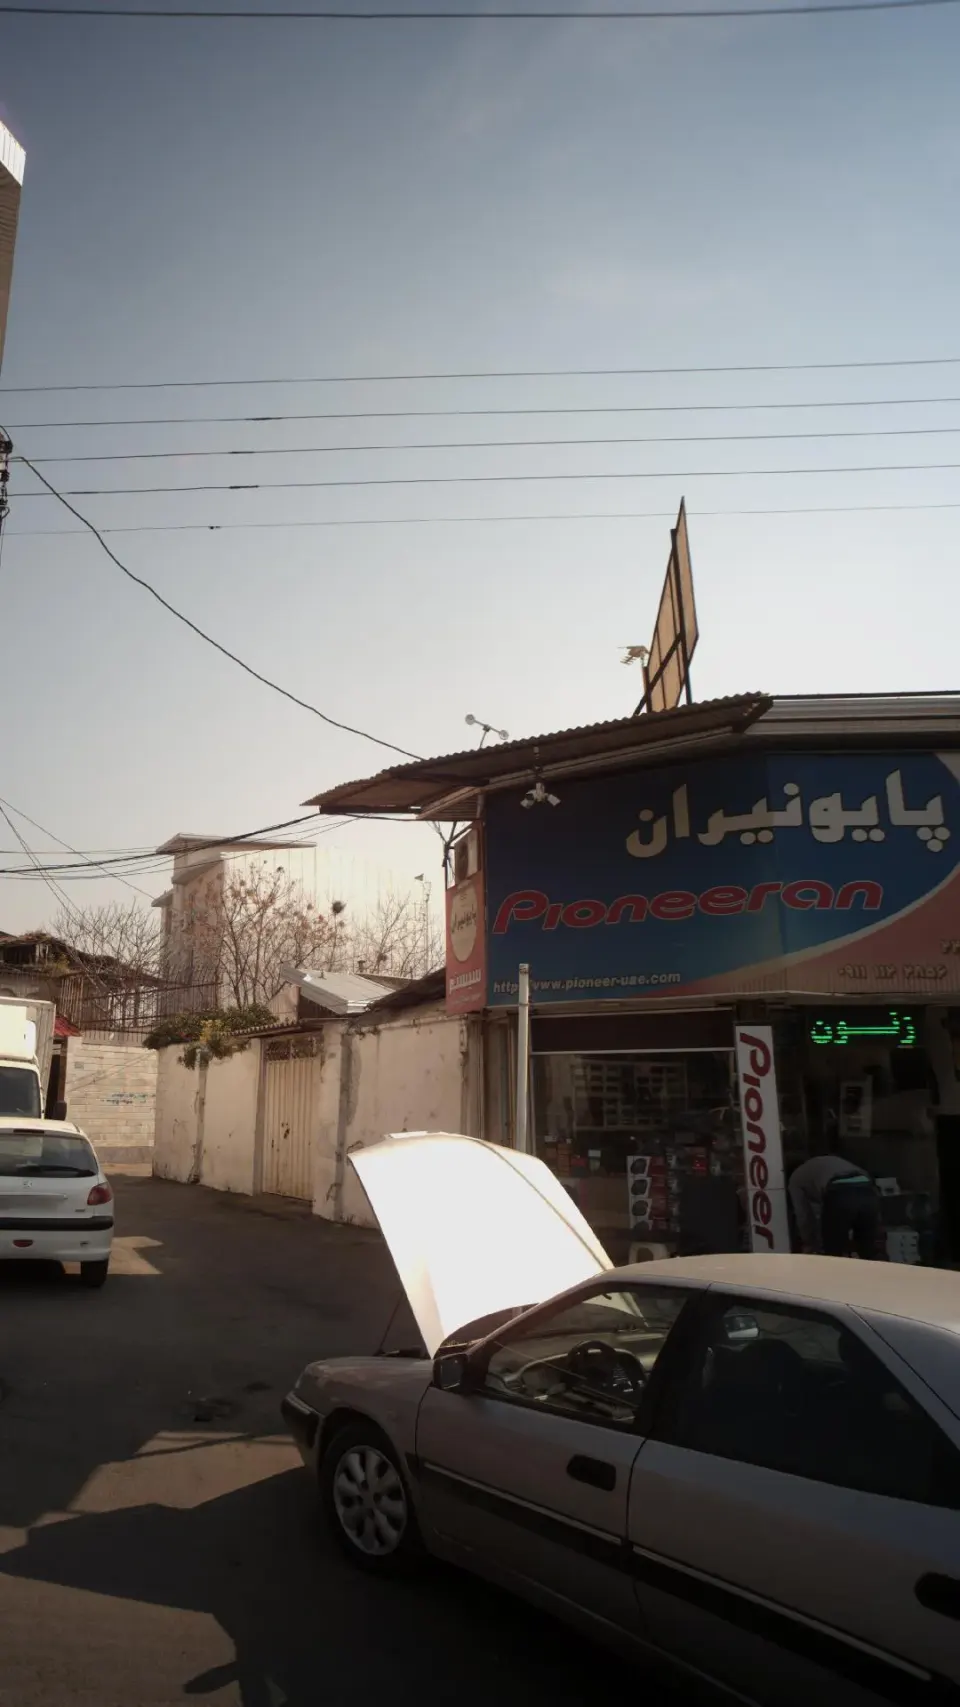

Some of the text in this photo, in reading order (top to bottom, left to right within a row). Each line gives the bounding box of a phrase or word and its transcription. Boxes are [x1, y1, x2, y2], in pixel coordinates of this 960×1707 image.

[626, 769, 951, 858] پایونیران
[493, 879, 883, 934] Pioneeran
[493, 972, 682, 995] httpwww.pioneer-uae.com
[837, 963, 867, 980] ۰۹۱۱
[739, 1032, 774, 1249] Pioneer
